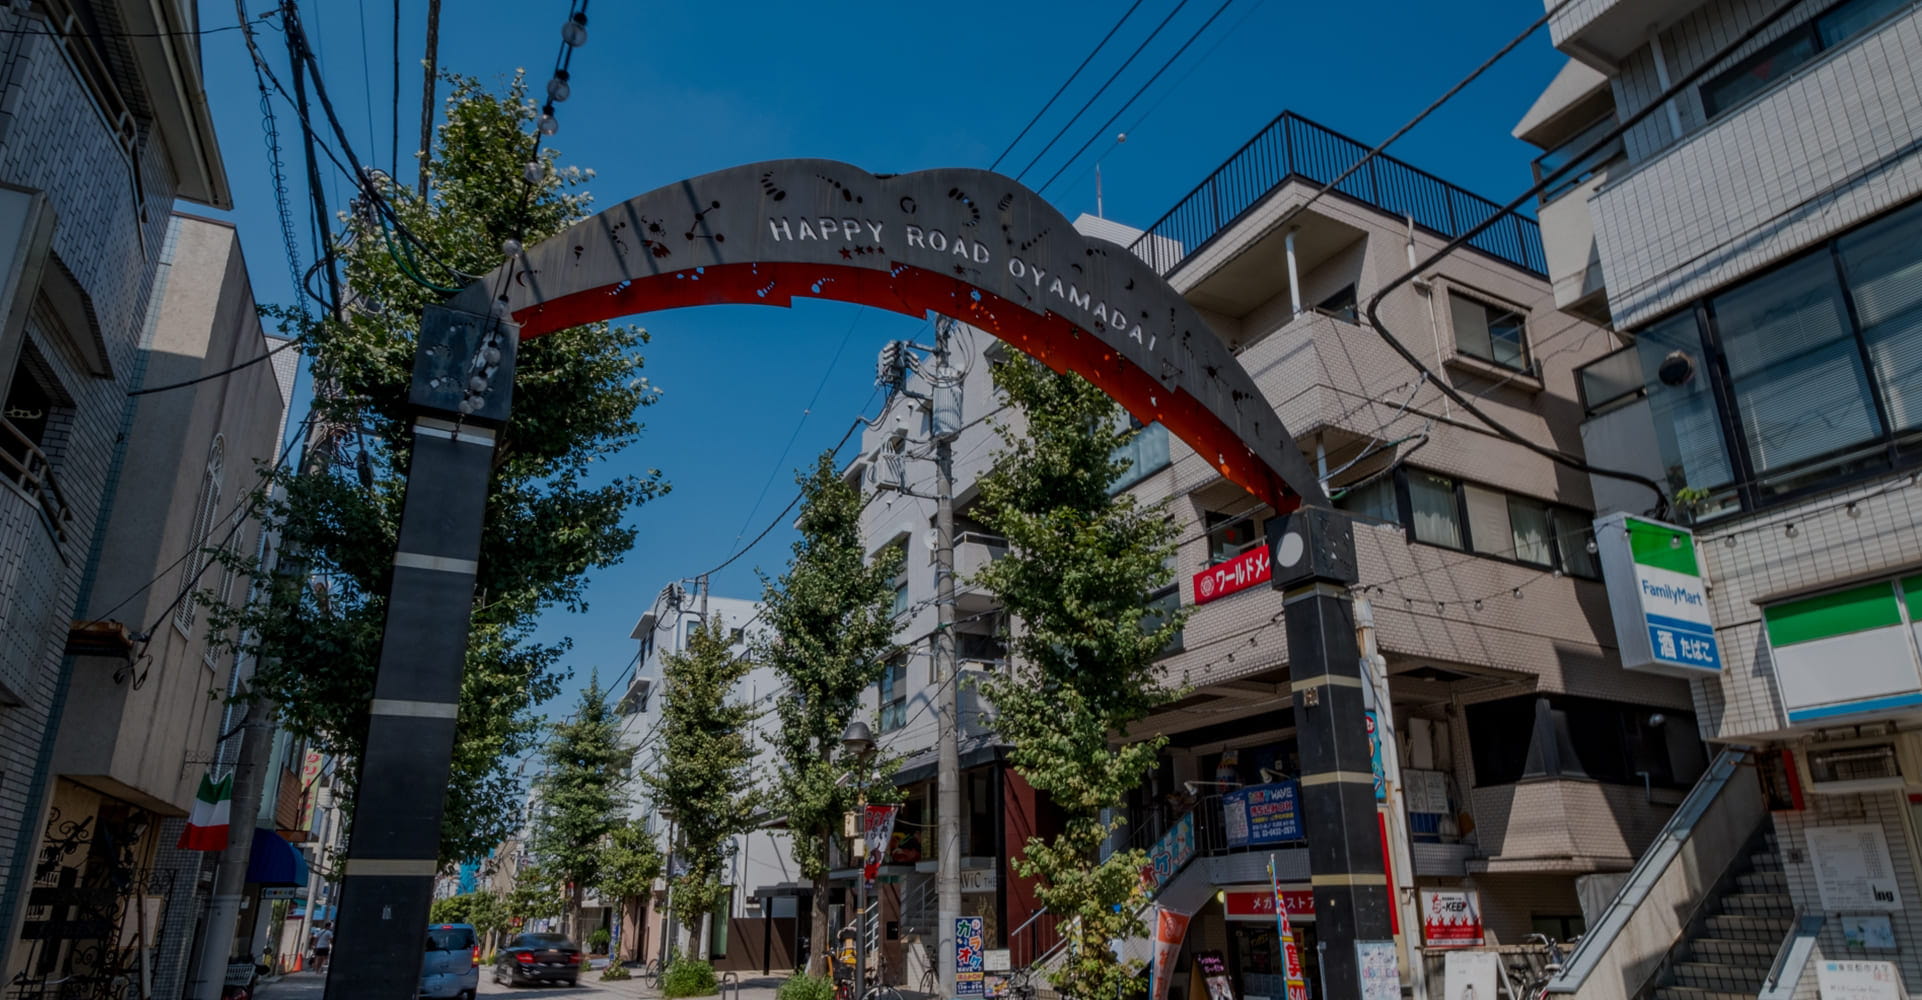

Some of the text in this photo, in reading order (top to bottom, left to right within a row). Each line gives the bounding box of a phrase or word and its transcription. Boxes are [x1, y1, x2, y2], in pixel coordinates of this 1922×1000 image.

[769, 216, 1157, 351] HAPPY ROAD OYAMADAI
[1642, 579, 1702, 607] FamilyMart
[1656, 629, 1714, 662] 酒 たばこ
[1252, 896, 1315, 910] メガストア
